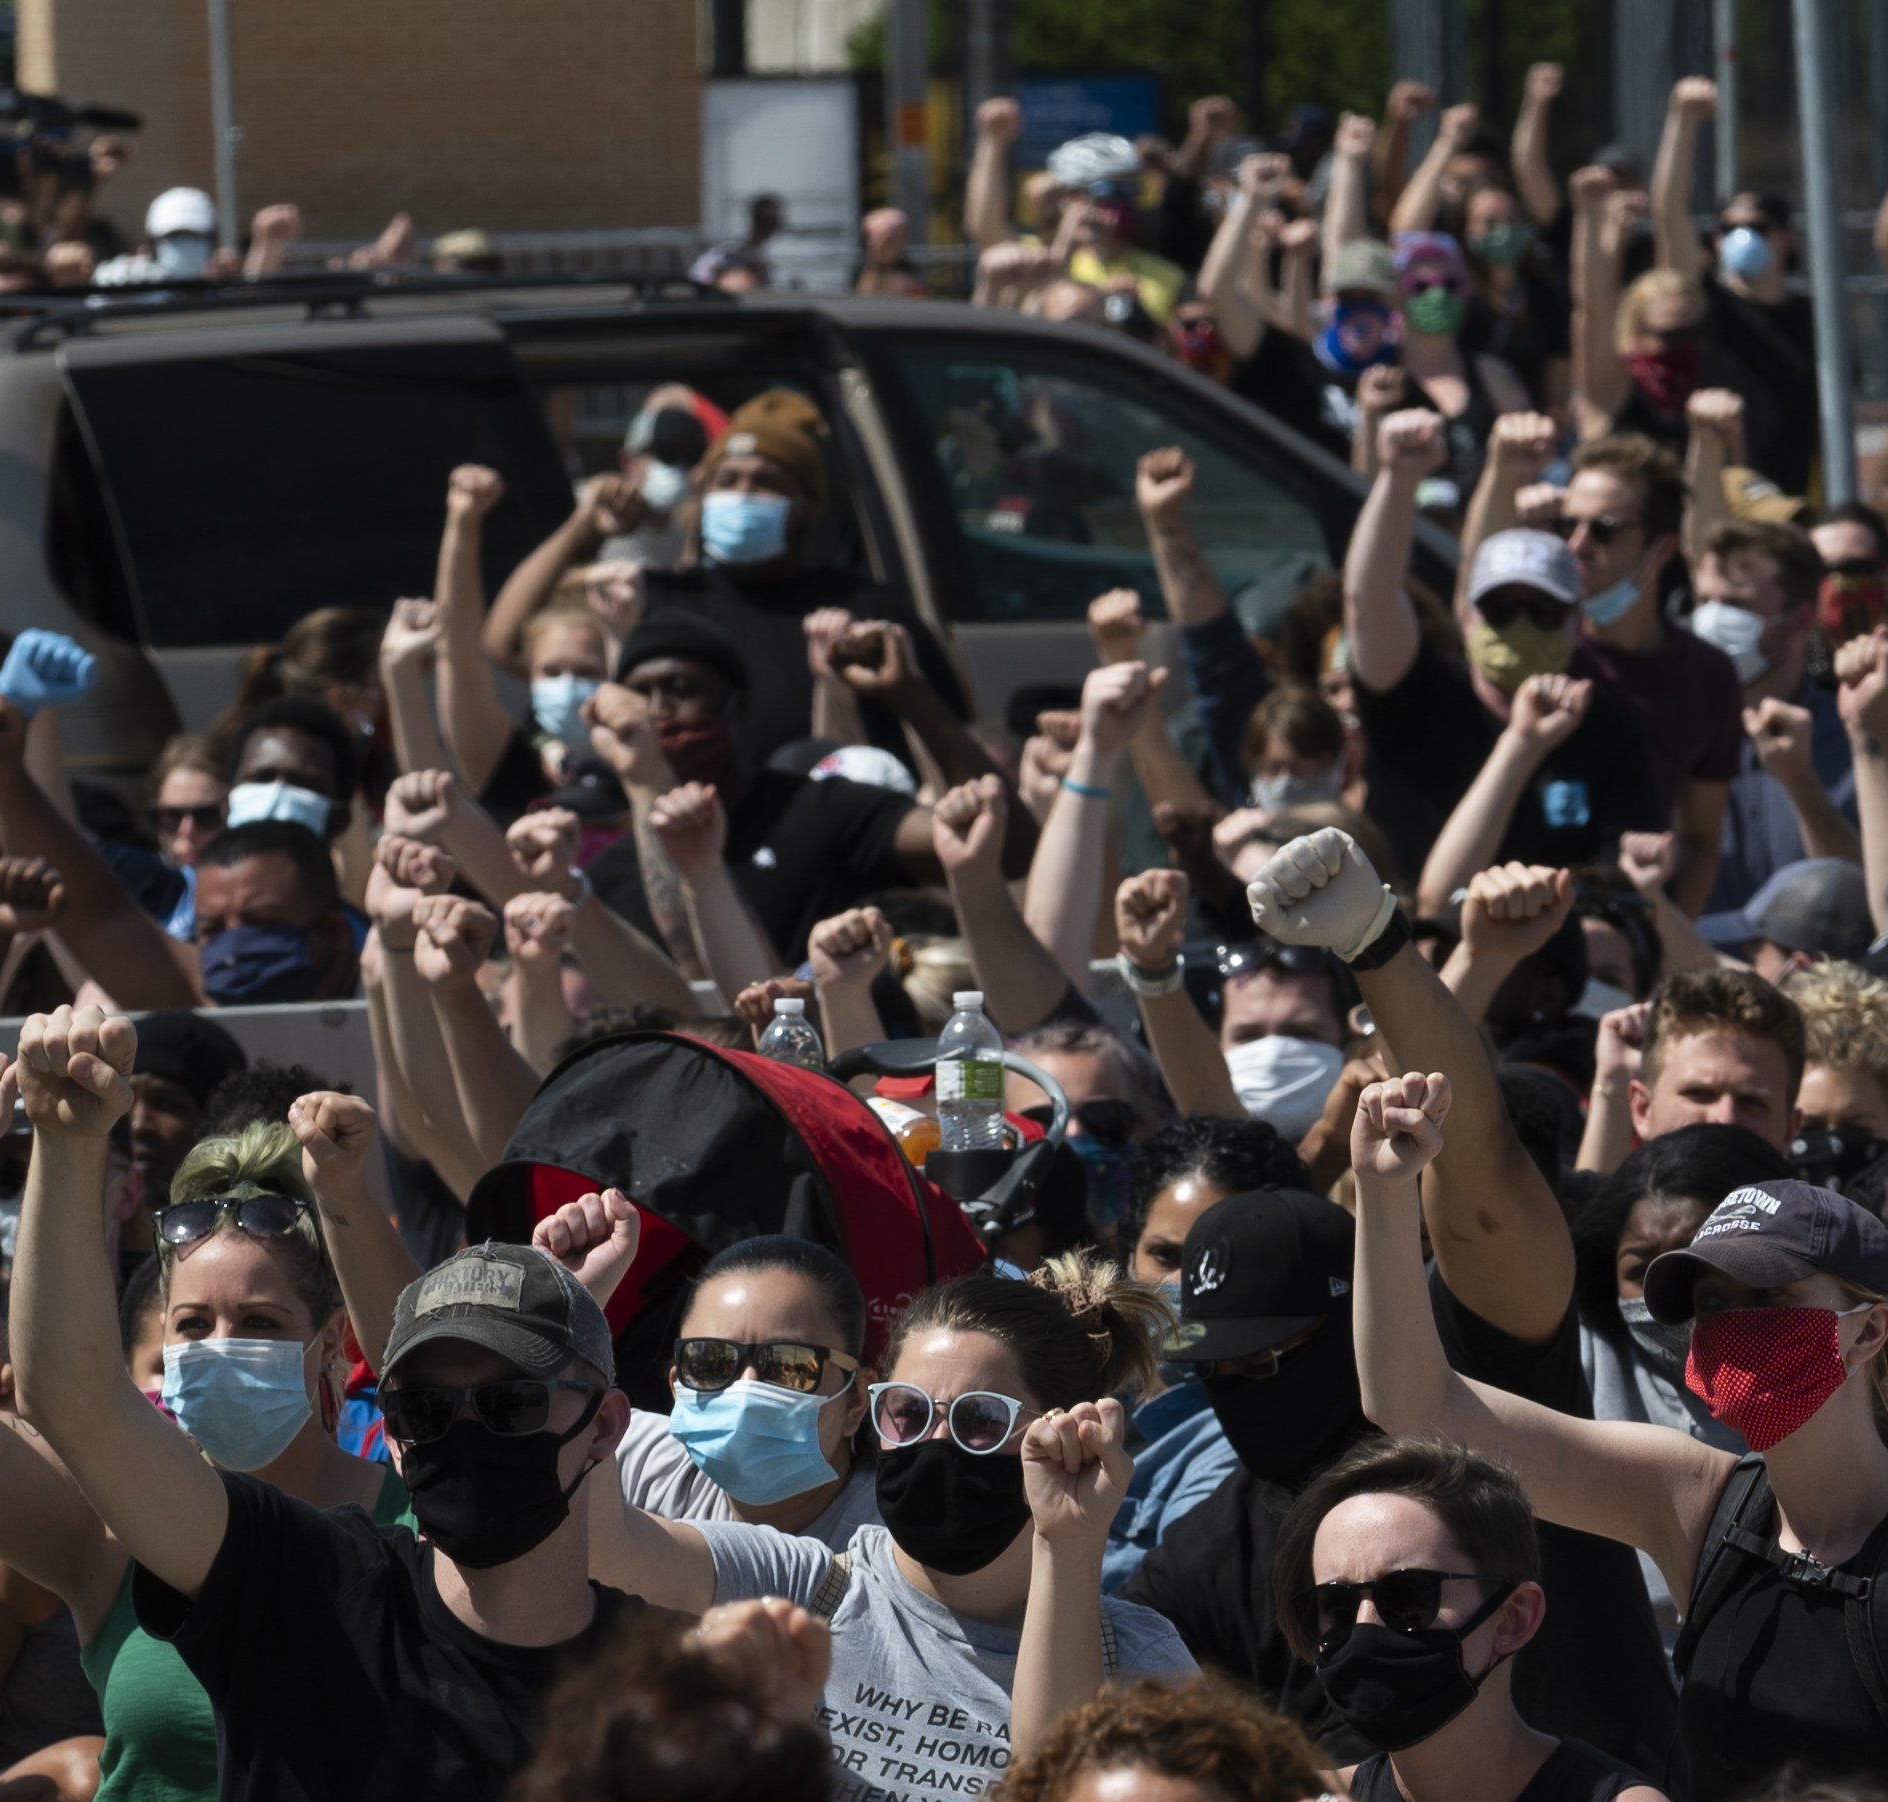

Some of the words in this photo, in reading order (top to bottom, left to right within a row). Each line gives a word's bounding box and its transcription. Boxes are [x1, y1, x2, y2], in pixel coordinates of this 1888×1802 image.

[434, 1265, 509, 1290] HISTORY
[856, 1684, 923, 1720] WHY
[928, 1705, 970, 1730] BE
